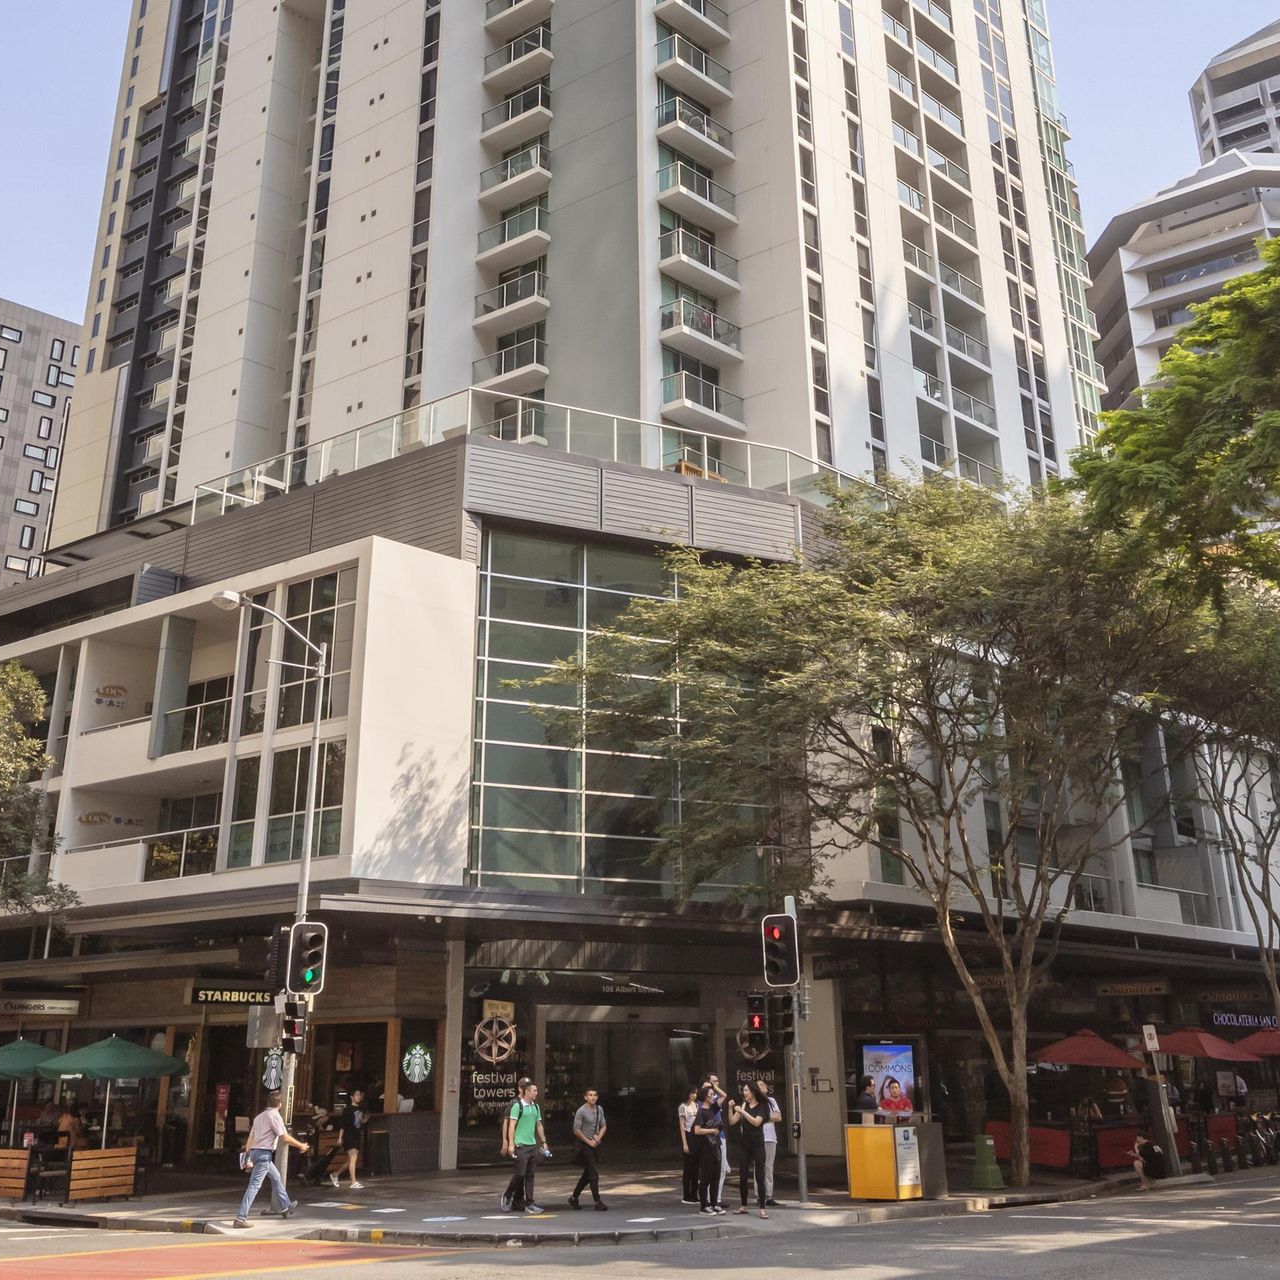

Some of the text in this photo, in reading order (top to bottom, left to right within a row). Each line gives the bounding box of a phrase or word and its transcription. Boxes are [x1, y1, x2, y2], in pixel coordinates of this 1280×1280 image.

[198, 990, 271, 1002] STARBUCKS
[1213, 1012, 1258, 1026] CHOCOLATERIA
[1259, 1015, 1271, 1027] SAN
[868, 1064, 912, 1073] COMMONS
[472, 1071, 517, 1084] festival
[736, 1070, 775, 1081] festival
[473, 1087, 516, 1098] towers
